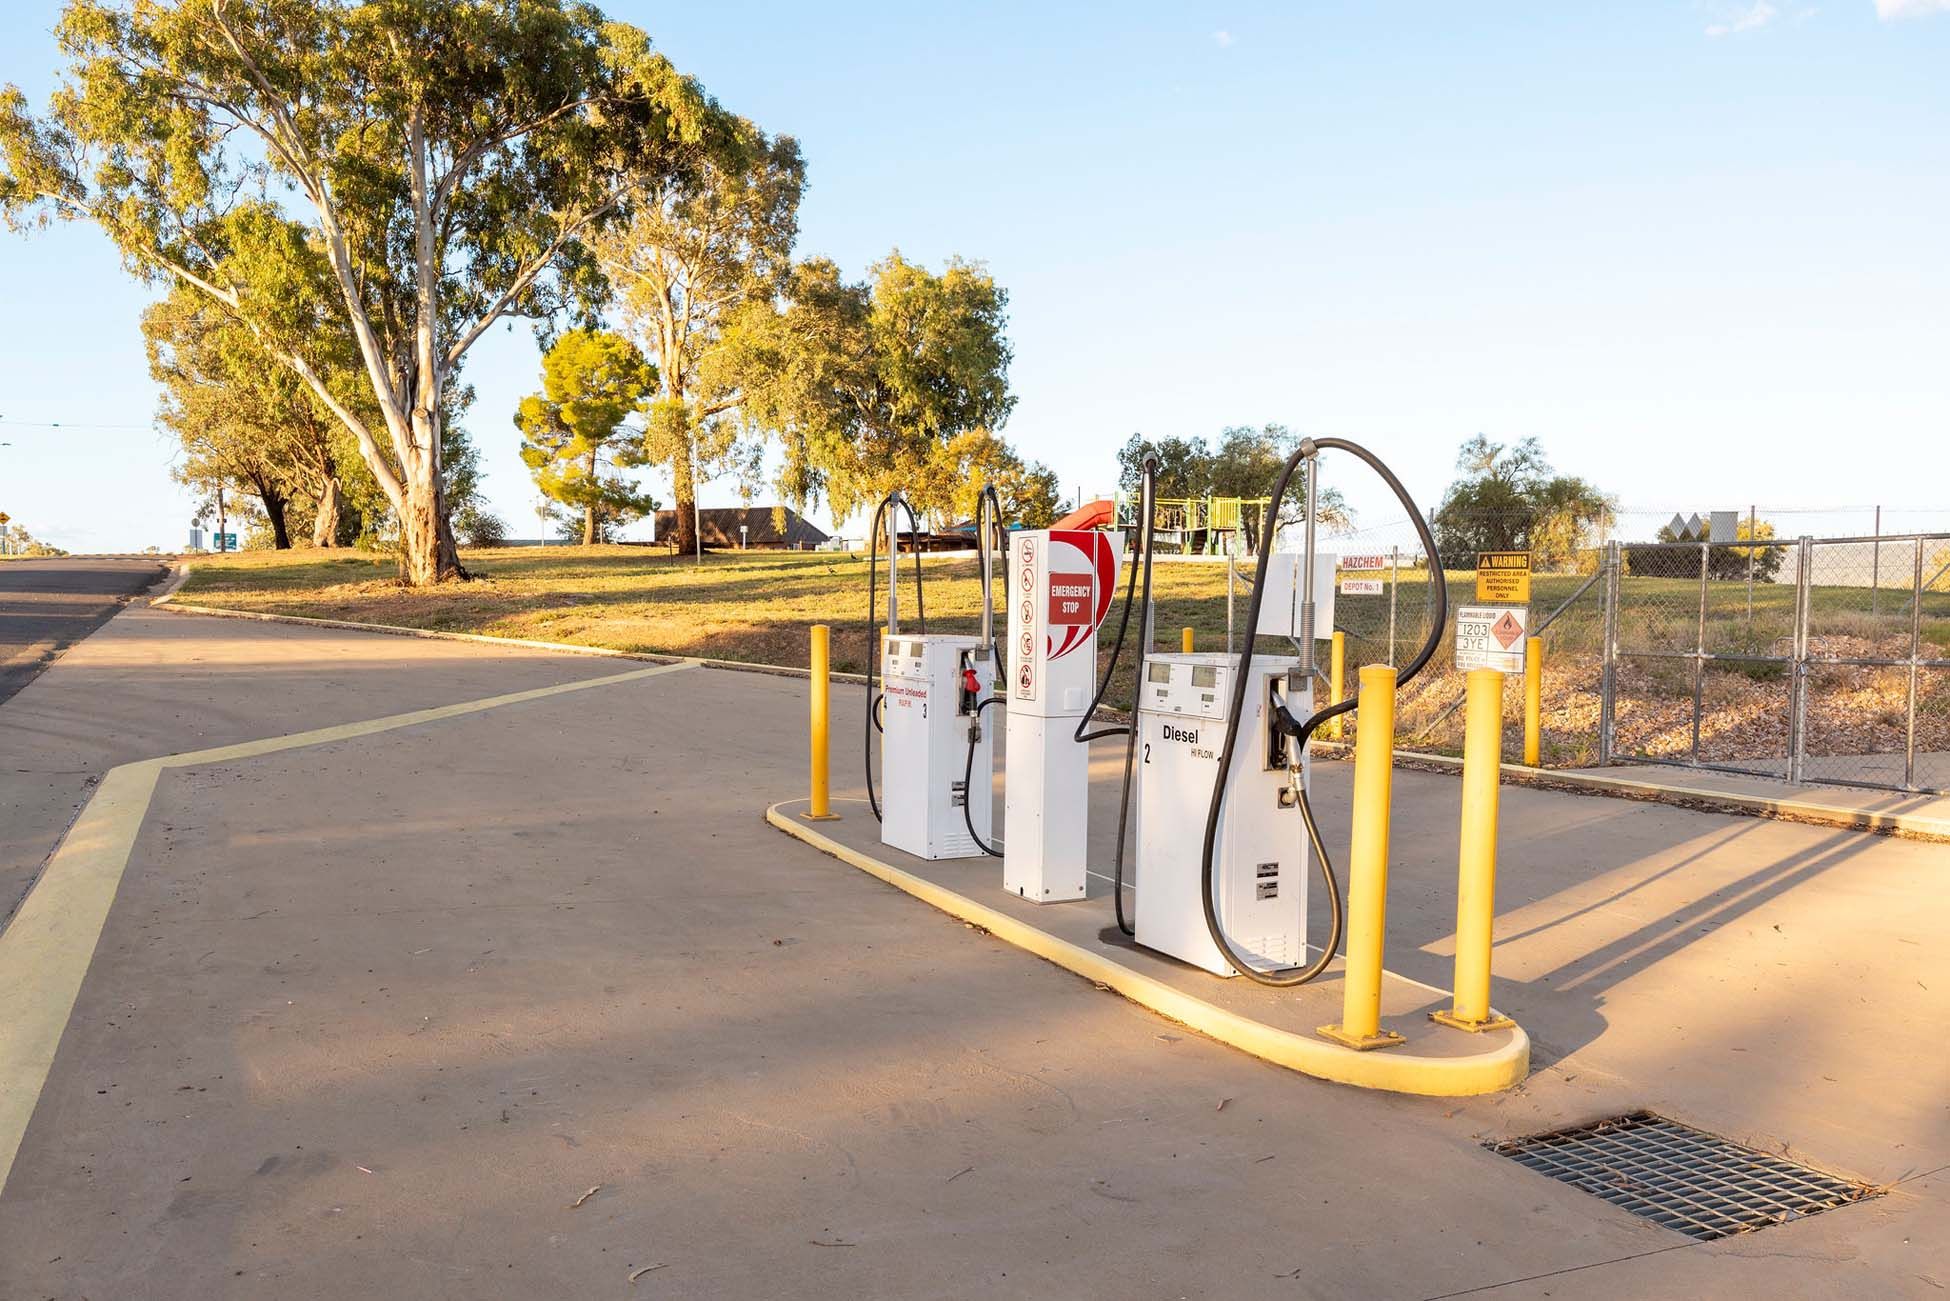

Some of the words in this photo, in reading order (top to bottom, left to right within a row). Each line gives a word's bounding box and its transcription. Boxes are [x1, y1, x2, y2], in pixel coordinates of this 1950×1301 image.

[1343, 556, 1383, 568] HAZCHEM
[1492, 555, 1527, 567] WARNING
[1051, 585, 1091, 598] EMERGENCY
[1344, 582, 1363, 591] DEPOT
[1364, 583, 1374, 591] No.
[1062, 602, 1080, 614] STOP
[1463, 624, 1487, 635] 1203
[1463, 638, 1483, 649] 3YE
[905, 688, 927, 698] Unleaded
[922, 703, 927, 719] 3
[1163, 725, 1199, 744] Diesel
[1144, 743, 1151, 764] 2
[1190, 748, 1197, 756] HI
[1198, 749, 1214, 760] FLOW
